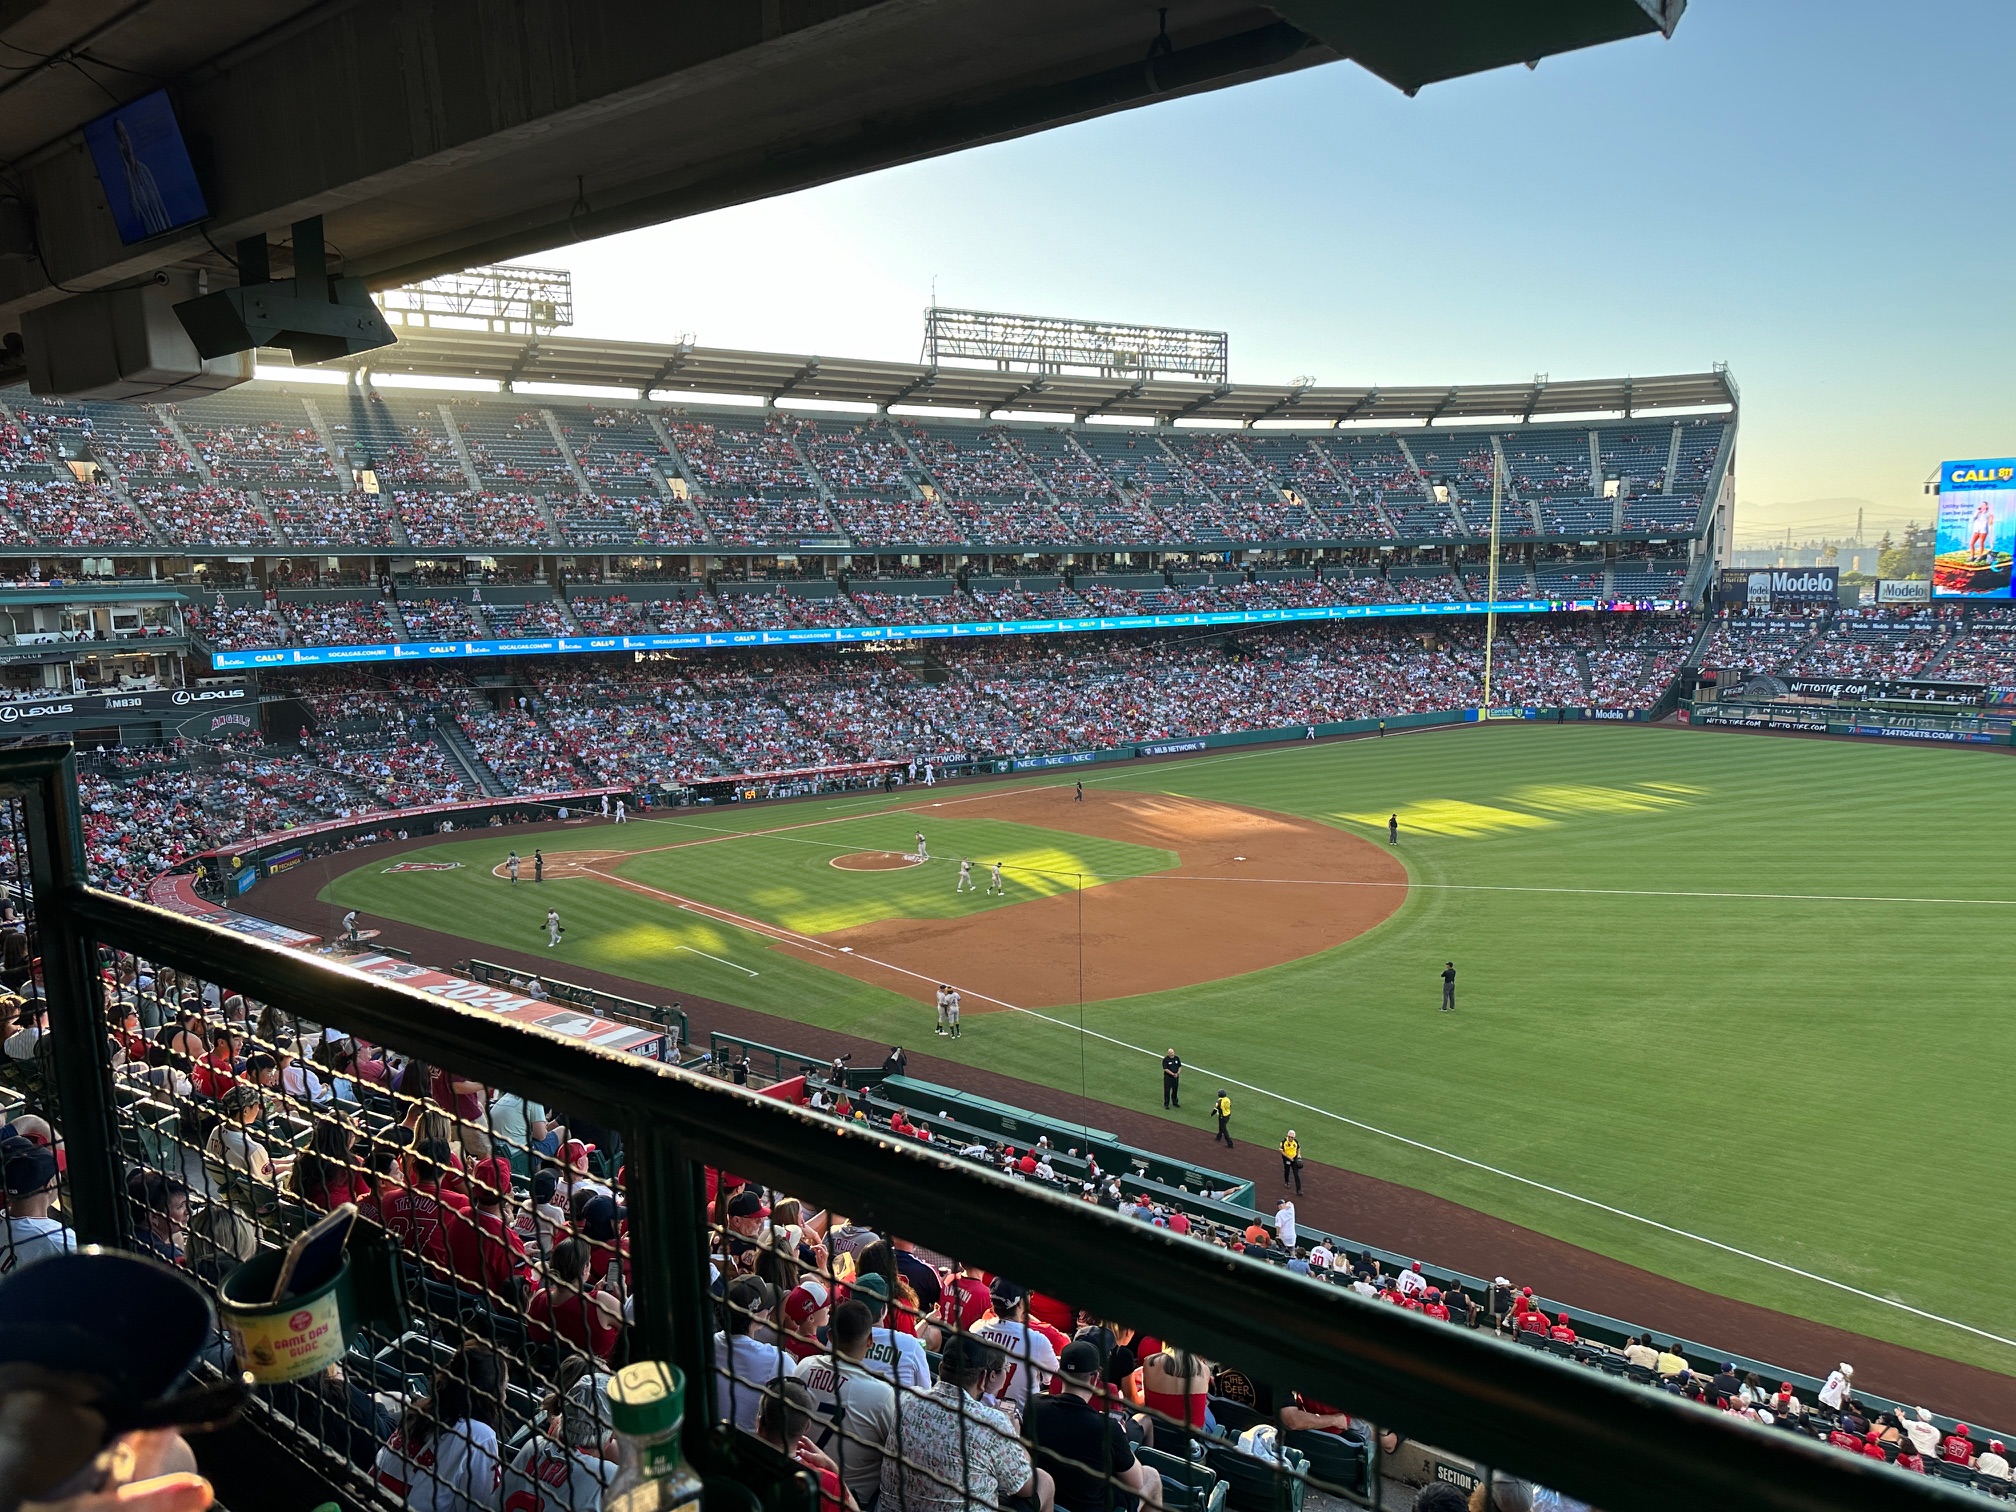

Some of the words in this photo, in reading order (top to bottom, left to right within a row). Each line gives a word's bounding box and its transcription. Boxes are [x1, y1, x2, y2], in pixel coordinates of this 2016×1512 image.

[1951, 469, 1996, 482] CALL
[1998, 468, 2014, 477] 811
[1772, 572, 1833, 592] Modelo
[1886, 584, 1924, 597] Modelo
[189, 689, 245, 700] LEXUS
[1791, 682, 1867, 694] NITTOTIRE.COM
[20, 704, 73, 717] LEXUS
[1595, 709, 1624, 719] Modelo
[211, 714, 250, 731] ANGELS
[1882, 729, 1954, 739] 714TICKETS.COM
[1154, 746, 1168, 754] MLB
[1169, 743, 1197, 752] NETWORK
[925, 754, 967, 764] NETWORK
[1045, 756, 1065, 765] NEC
[1072, 753, 1092, 762] NEC
[278, 858, 301, 870] PECHANGA
[421, 980, 538, 1014] 2024
[629, 1042, 657, 1056] MLB
[394, 1196, 438, 1214] TROUT
[1311, 1254, 1324, 1266] 30
[944, 1286, 972, 1304] OHANI
[274, 1334, 306, 1350] GAME
[309, 1323, 328, 1339] DAY
[290, 1341, 318, 1357] GUAC
[866, 1342, 902, 1364] RSON
[807, 1368, 848, 1392] TROUT
[1227, 1374, 1244, 1384] THE
[1224, 1380, 1252, 1396] BEER
[1949, 1444, 1966, 1458] 27
[654, 1456, 665, 1465] ALL
[1438, 1466, 1471, 1489] SECTION
